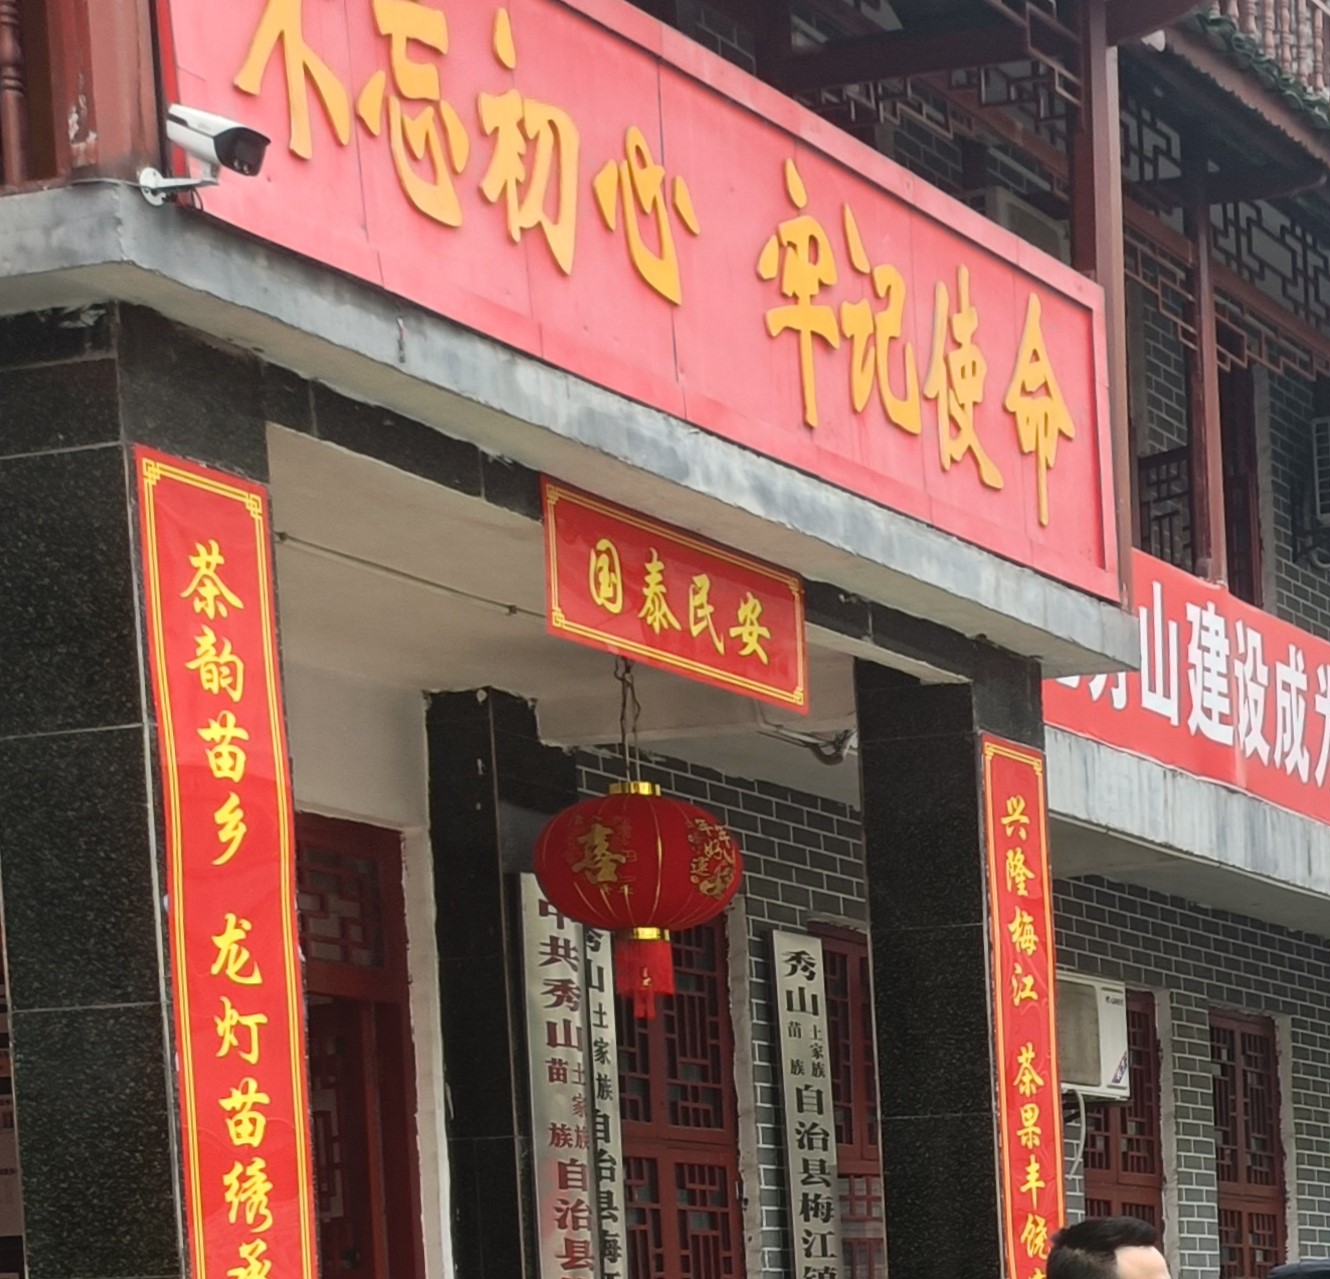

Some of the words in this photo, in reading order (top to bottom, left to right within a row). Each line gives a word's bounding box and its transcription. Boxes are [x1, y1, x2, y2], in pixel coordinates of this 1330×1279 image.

[234, 0, 700, 306] 不忘初心
[757, 159, 1075, 527] 牢记使命
[180, 540, 249, 866] 茶韵苗乡
[588, 538, 772, 666] 国泰民安
[1000, 795, 1040, 1006] 兴隆梅江
